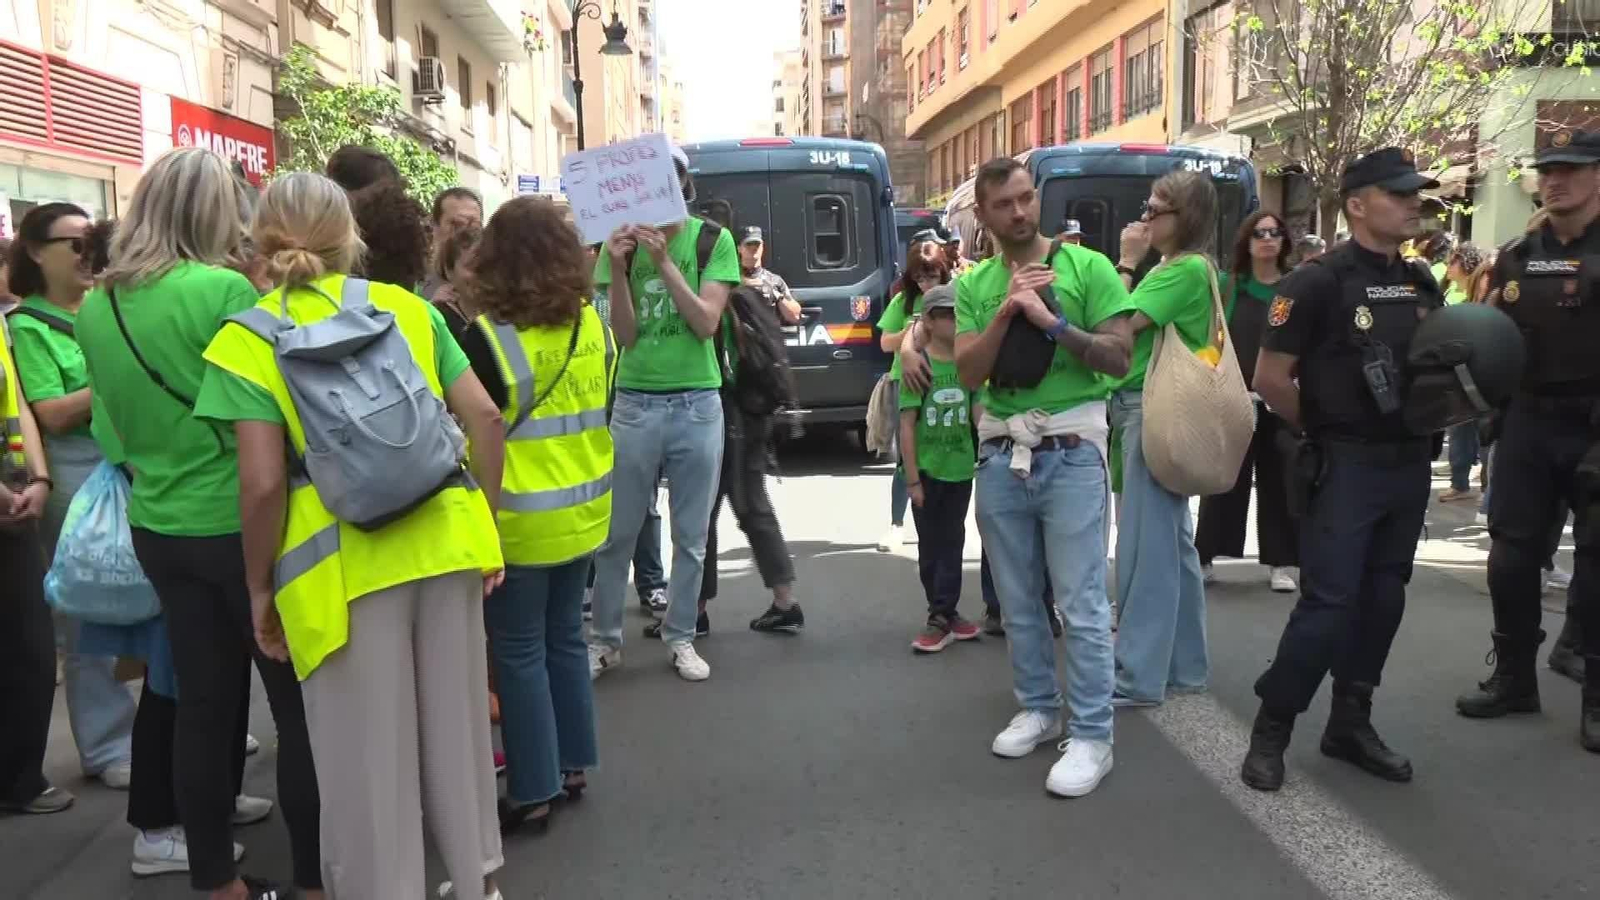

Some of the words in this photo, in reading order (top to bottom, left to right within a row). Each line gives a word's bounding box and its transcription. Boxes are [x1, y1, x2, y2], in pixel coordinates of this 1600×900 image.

[194, 127, 268, 174] MAPFRE
[567, 160, 589, 185] 5
[580, 207, 598, 219] EL
